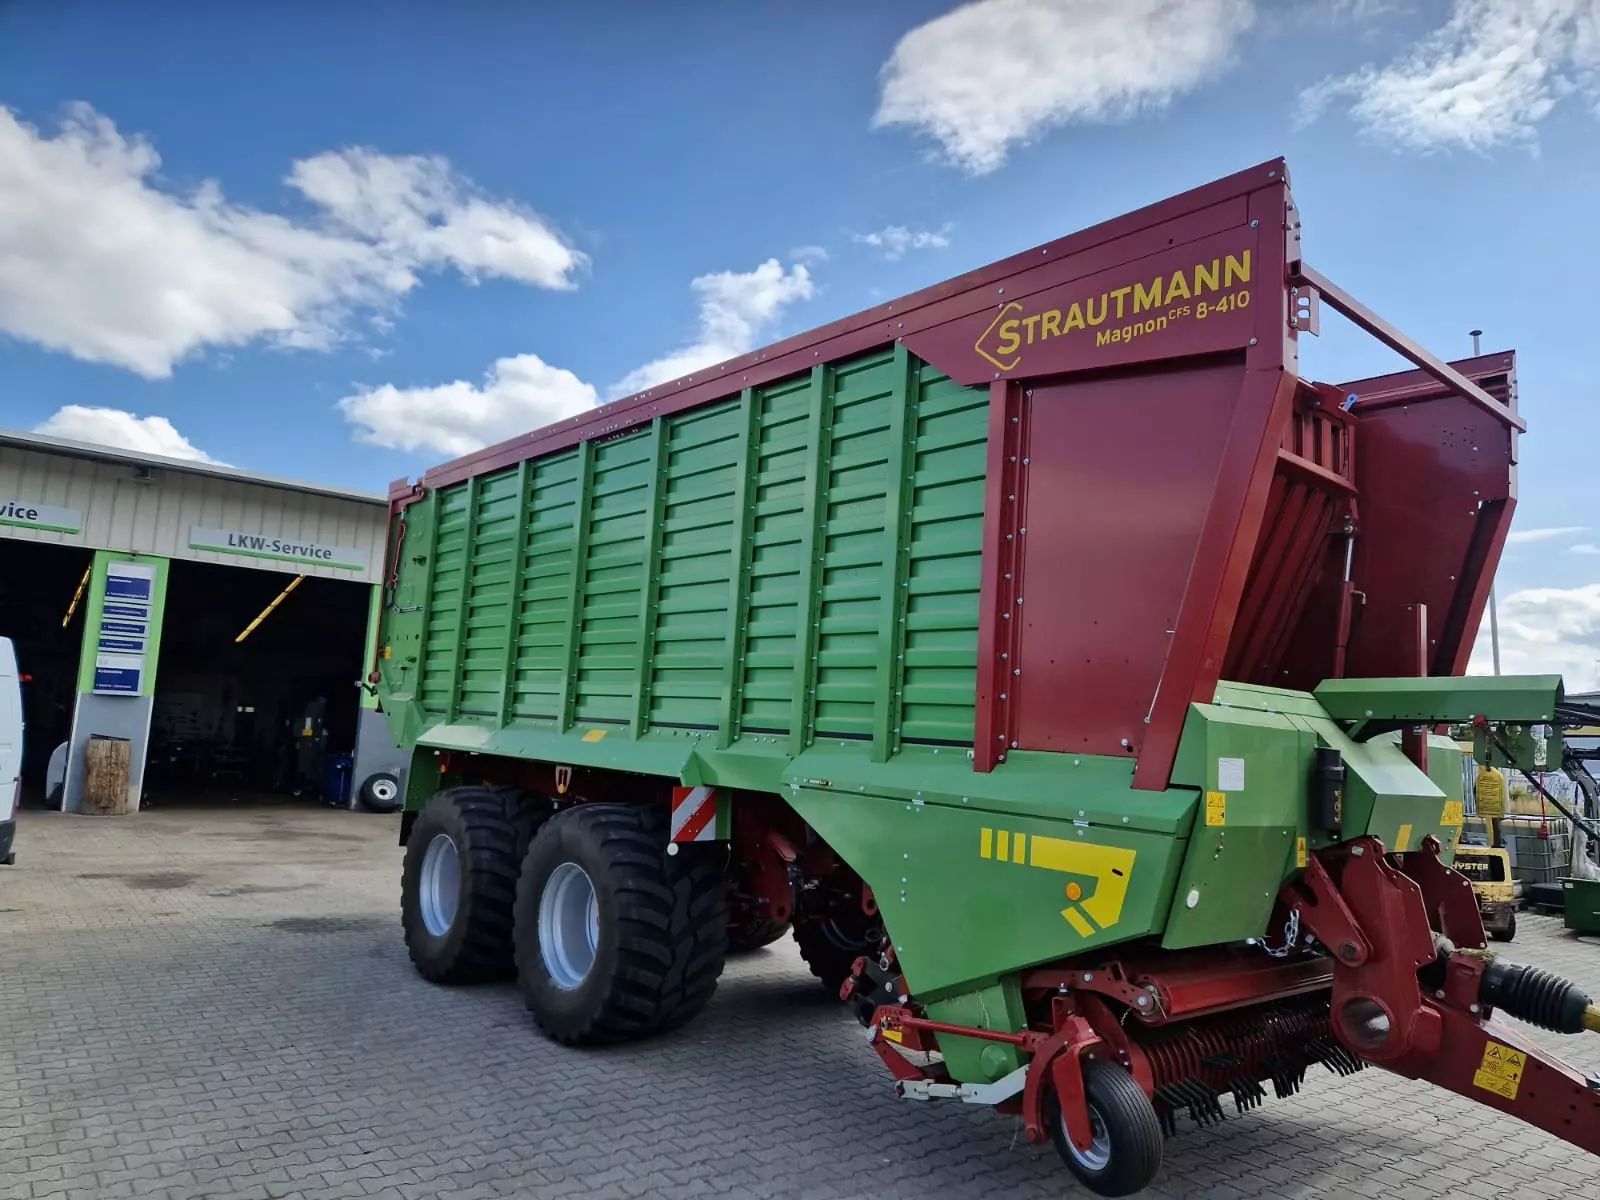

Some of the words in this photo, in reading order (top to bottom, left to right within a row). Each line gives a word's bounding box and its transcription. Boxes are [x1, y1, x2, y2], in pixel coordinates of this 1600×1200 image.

[996, 248, 1252, 356] STRAUTMANN
[1095, 315, 1168, 348] Magnon
[1168, 304, 1191, 322] CFS
[1195, 289, 1251, 320] 8-410
[227, 532, 333, 561] LKW-Service
